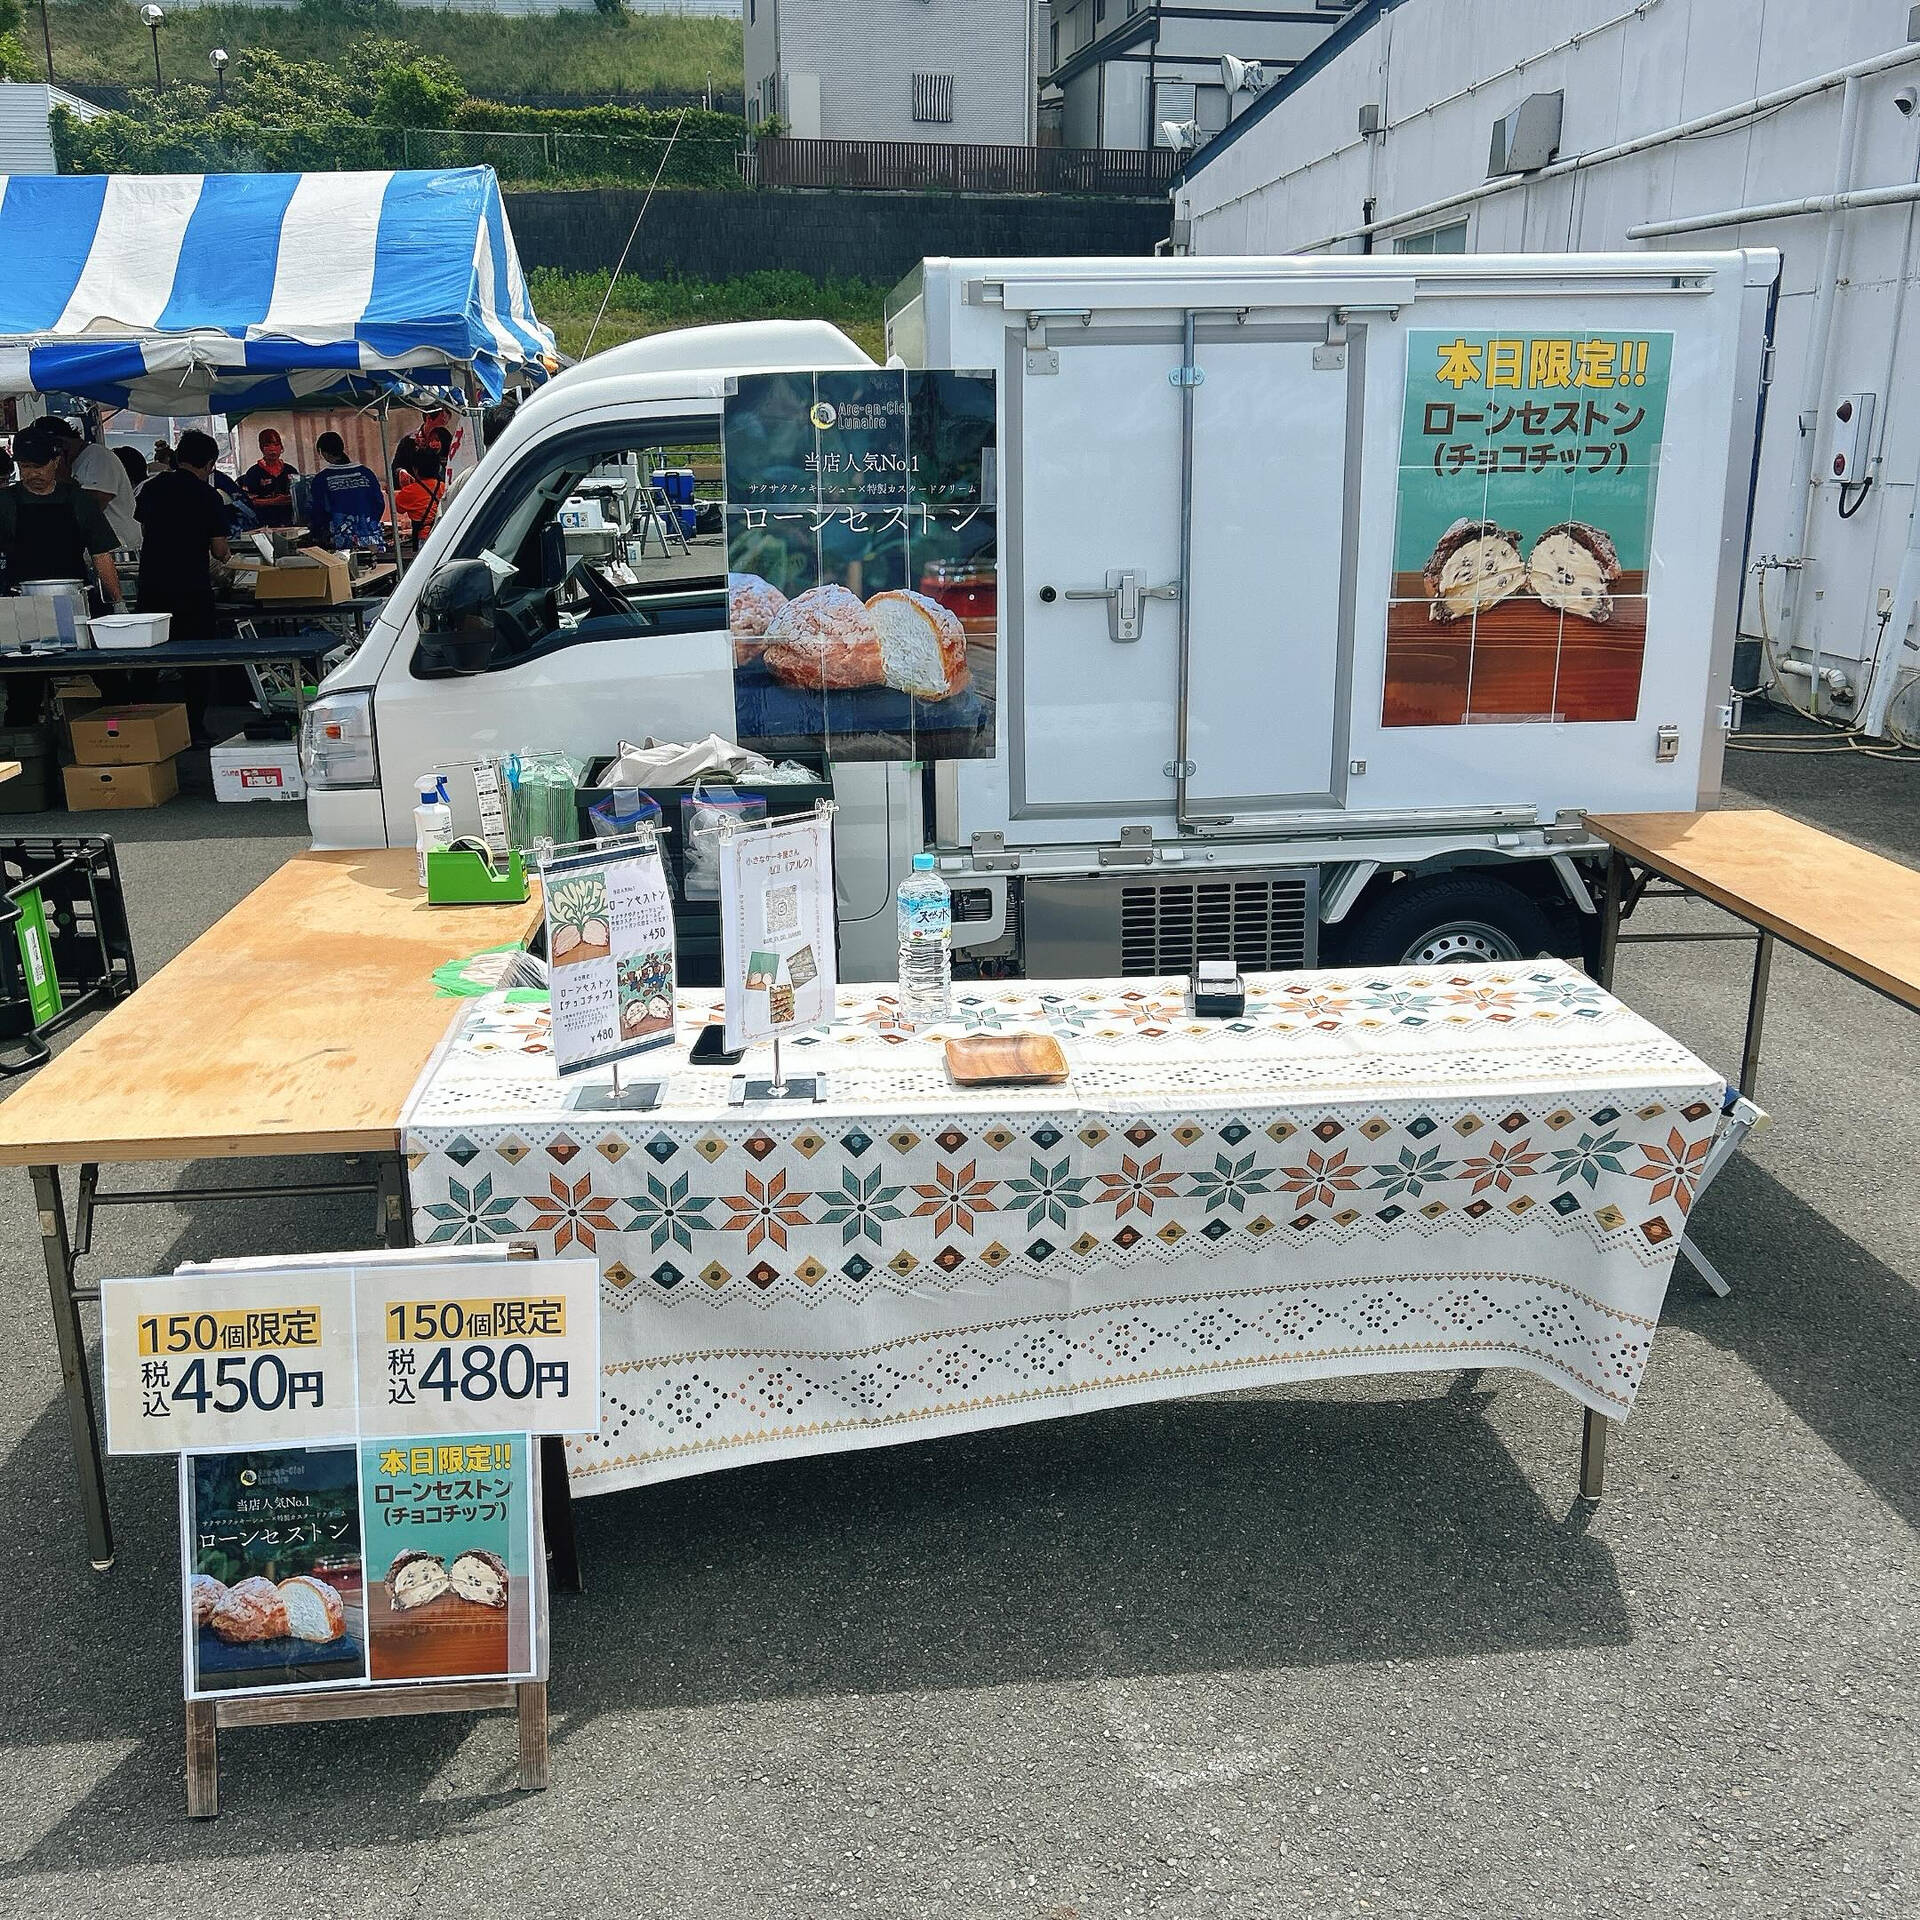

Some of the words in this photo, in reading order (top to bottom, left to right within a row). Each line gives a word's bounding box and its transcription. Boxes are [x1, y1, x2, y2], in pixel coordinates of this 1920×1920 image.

[1435, 338, 1650, 390] 本日限定!!
[838, 415, 888, 430] Lunaire
[1422, 400, 1646, 436] ローンセストン
[804, 453, 920, 473] 当店人気No.1
[1433, 443, 1628, 477] (チョコチップ)
[743, 501, 980, 535] ローンセストン
[609, 890, 666, 911] ローンセストン
[917, 908, 950, 923] 天然水
[643, 926, 666, 942] ¥450
[561, 979, 612, 998] ローンセストン
[591, 1027, 614, 1043] ¥480
[140, 1310, 318, 1353] 150個限定
[388, 1299, 563, 1341] 150個限定
[141, 1360, 171, 1419] 税込
[171, 1354, 325, 1414] 450円
[387, 1347, 416, 1406] 税込
[417, 1343, 569, 1401] 480円
[378, 1443, 512, 1477] 本日限定!!
[236, 1496, 310, 1512] 当店人気No.1
[375, 1479, 513, 1504] ローンセストン
[384, 1501, 507, 1527] (チョコチップ)
[199, 1522, 350, 1549] ローンセストン
